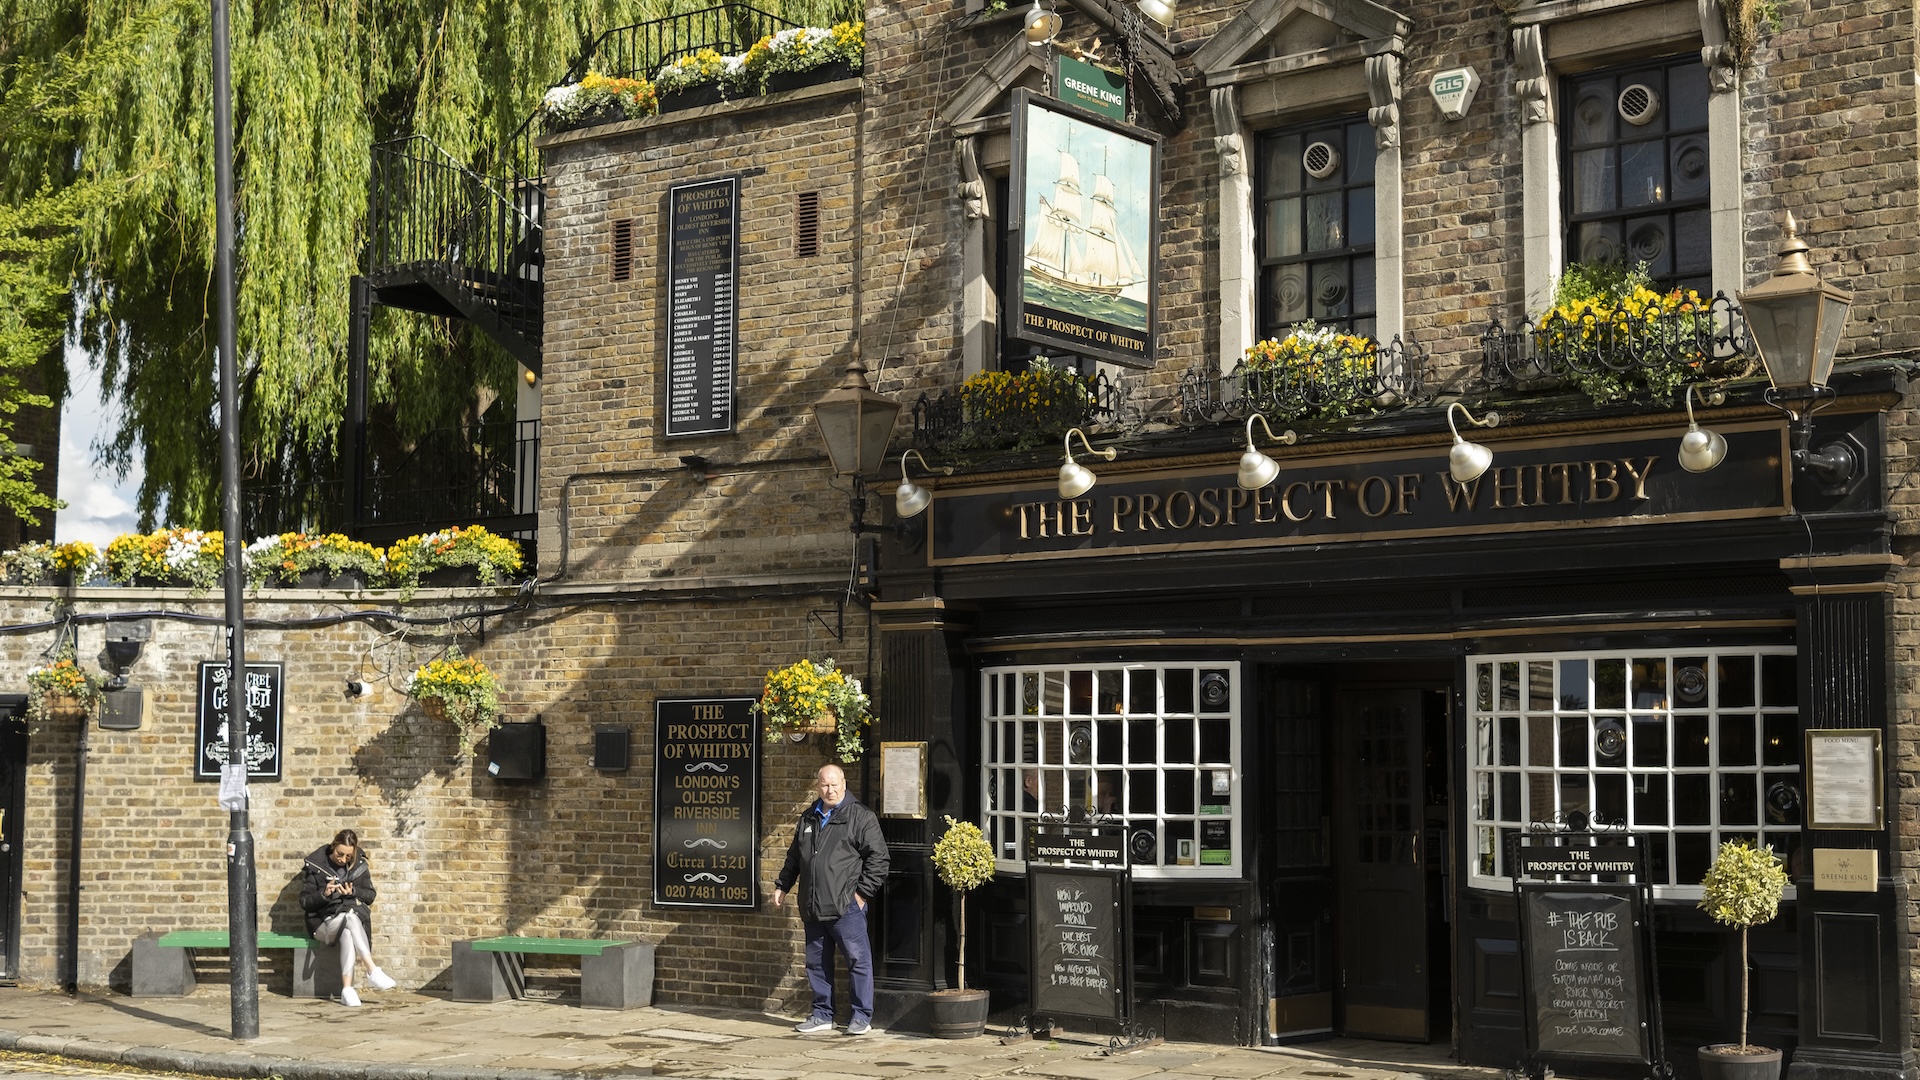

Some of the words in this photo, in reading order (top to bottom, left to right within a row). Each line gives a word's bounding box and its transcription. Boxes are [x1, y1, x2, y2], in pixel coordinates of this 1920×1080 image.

[1064, 78, 1098, 98] GREENE
[1100, 89, 1122, 106] KING
[680, 187, 730, 202] PROSPECT
[678, 203, 691, 214] OF
[692, 198, 731, 212] WHITBY
[689, 212, 719, 222] LONDON'S
[677, 222, 699, 231] OLDEST
[700, 218, 731, 228] RIVERSIDE
[674, 315, 711, 324] COMMONWEALTH
[1024, 312, 1044, 328] THE
[1046, 318, 1094, 340] PROSPECT
[1095, 330, 1108, 343] OF
[1109, 334, 1146, 352] WHITBY
[1011, 498, 1096, 540] THE
[1108, 480, 1344, 534] PROSPECT
[1356, 473, 1422, 518] OF
[1435, 456, 1660, 513] WHITBY
[692, 704, 725, 721] THE
[667, 723, 750, 740] PROSPECT
[664, 744, 686, 759] OF
[687, 743, 752, 759] WHITBY
[675, 775, 740, 789] LONDON'S
[682, 791, 732, 805] OLDEST
[674, 807, 740, 820] RIVERSIDE
[696, 822, 717, 835] INN
[1068, 839, 1084, 847] THE
[1037, 847, 1075, 857] PROSPECT
[1075, 848, 1086, 857] OF
[1087, 849, 1118, 858] WHITBY
[1568, 851, 1590, 860] THE
[667, 851, 705, 869] Circa
[711, 855, 747, 869] 1520
[1527, 861, 1576, 871] PROSPECT
[1578, 861, 1592, 871] OF
[1593, 861, 1634, 871] WHITBY
[665, 885, 686, 898] 020
[689, 886, 716, 899] 7481
[720, 887, 748, 900] 1095
[1074, 890, 1085, 900] &
[1059, 901, 1093, 914] IMPROVED
[1064, 913, 1087, 925] MENU
[1546, 912, 1563, 927] #
[1564, 911, 1592, 930] THE
[1593, 912, 1618, 931] PUB
[1062, 931, 1075, 942] OUR
[1075, 931, 1092, 943] BEST
[1563, 929, 1576, 949] IS
[1578, 930, 1614, 947] BACK
[1059, 942, 1080, 956] PIES
[1080, 943, 1102, 958] EVER
[1555, 959, 1578, 971] COME
[1608, 962, 1620, 972] OR
[1050, 974, 1057, 985] &
[1069, 976, 1085, 987] BEEF
[1085, 977, 1109, 994] BURGER
[1578, 974, 1624, 990] AMAZING
[1564, 987, 1591, 998] RIVER
[1553, 999, 1575, 1008] FROM
[1577, 1000, 1594, 1009] OUR
[1596, 1000, 1625, 1009] SECRET
[1569, 1009, 1608, 1021] GARDEN
[1555, 1025, 1578, 1036] DOGS
[1581, 1026, 1624, 1036] WELCOME
